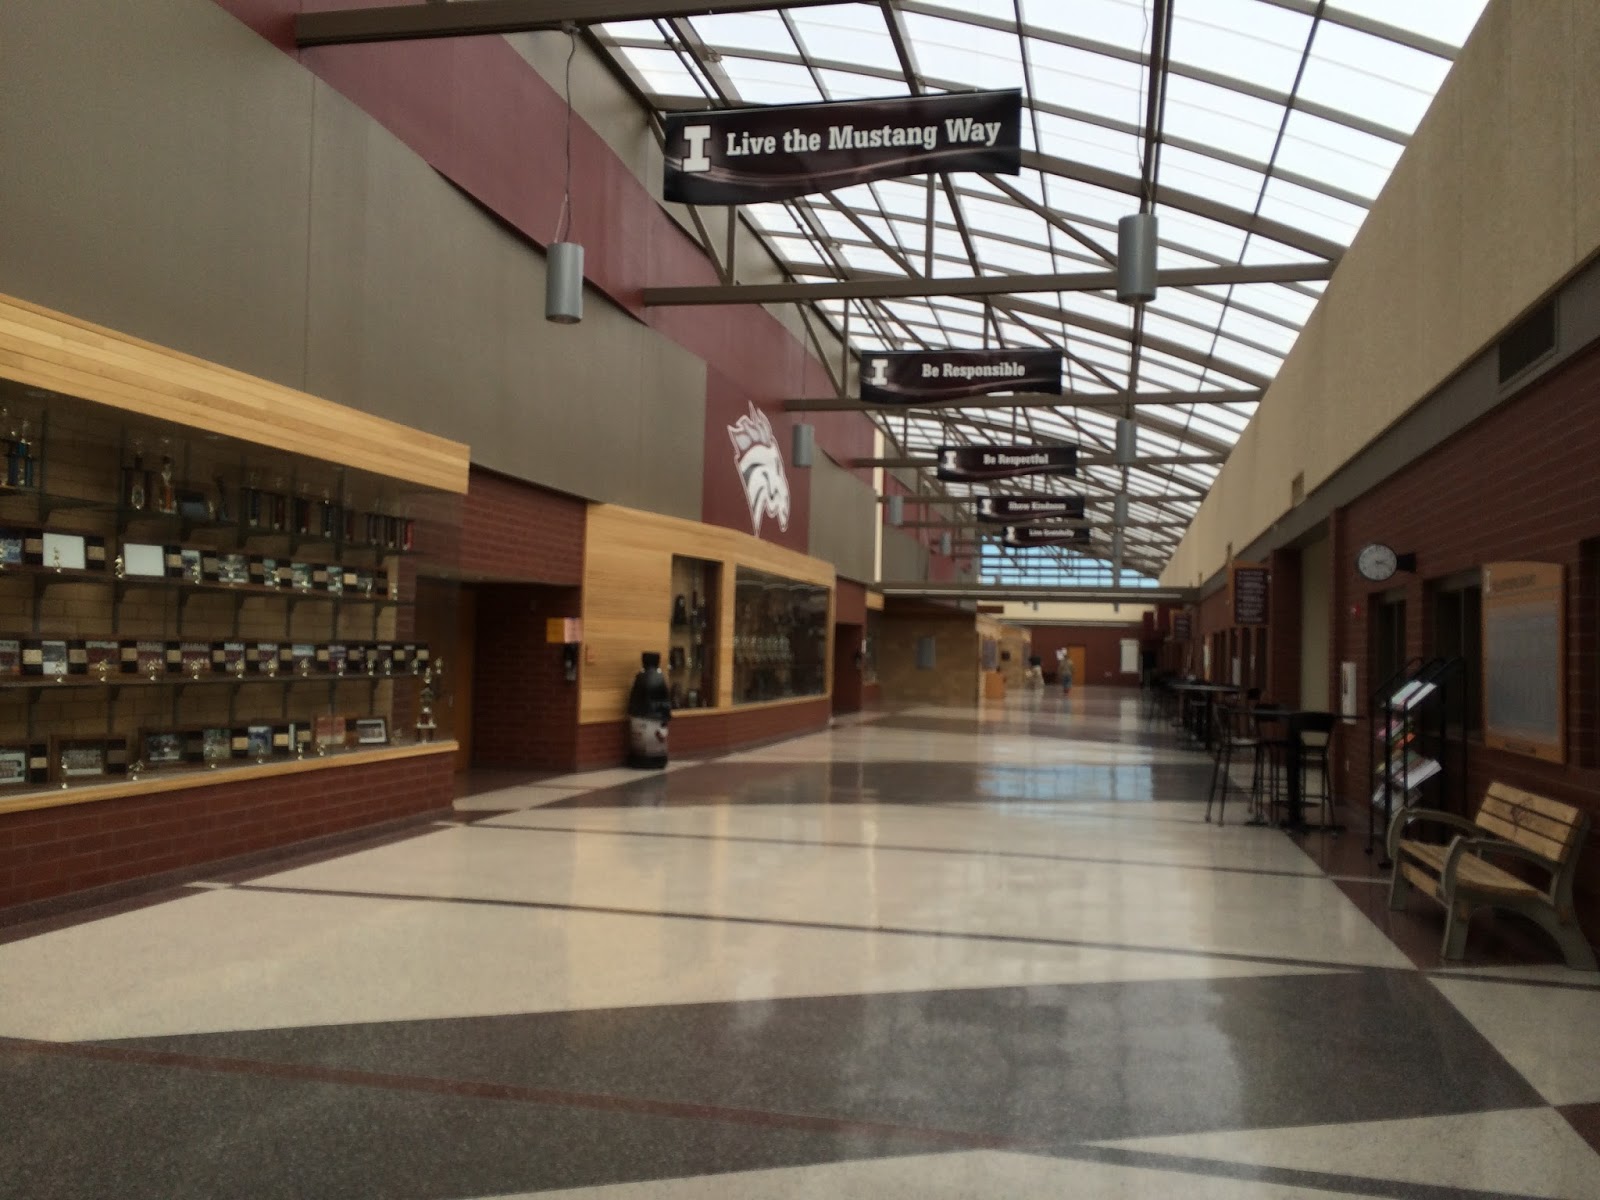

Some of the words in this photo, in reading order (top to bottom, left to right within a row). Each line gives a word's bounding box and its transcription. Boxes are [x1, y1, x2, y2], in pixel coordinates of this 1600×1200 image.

[683, 125, 711, 172] I
[726, 132, 776, 156] Live
[783, 128, 821, 153] the
[828, 123, 938, 151] Mustang
[945, 117, 1001, 148] Way
[921, 363, 940, 378] Be
[942, 361, 1026, 380] Responsible
[983, 453, 996, 465] Be
[998, 453, 1049, 467] Respectful
